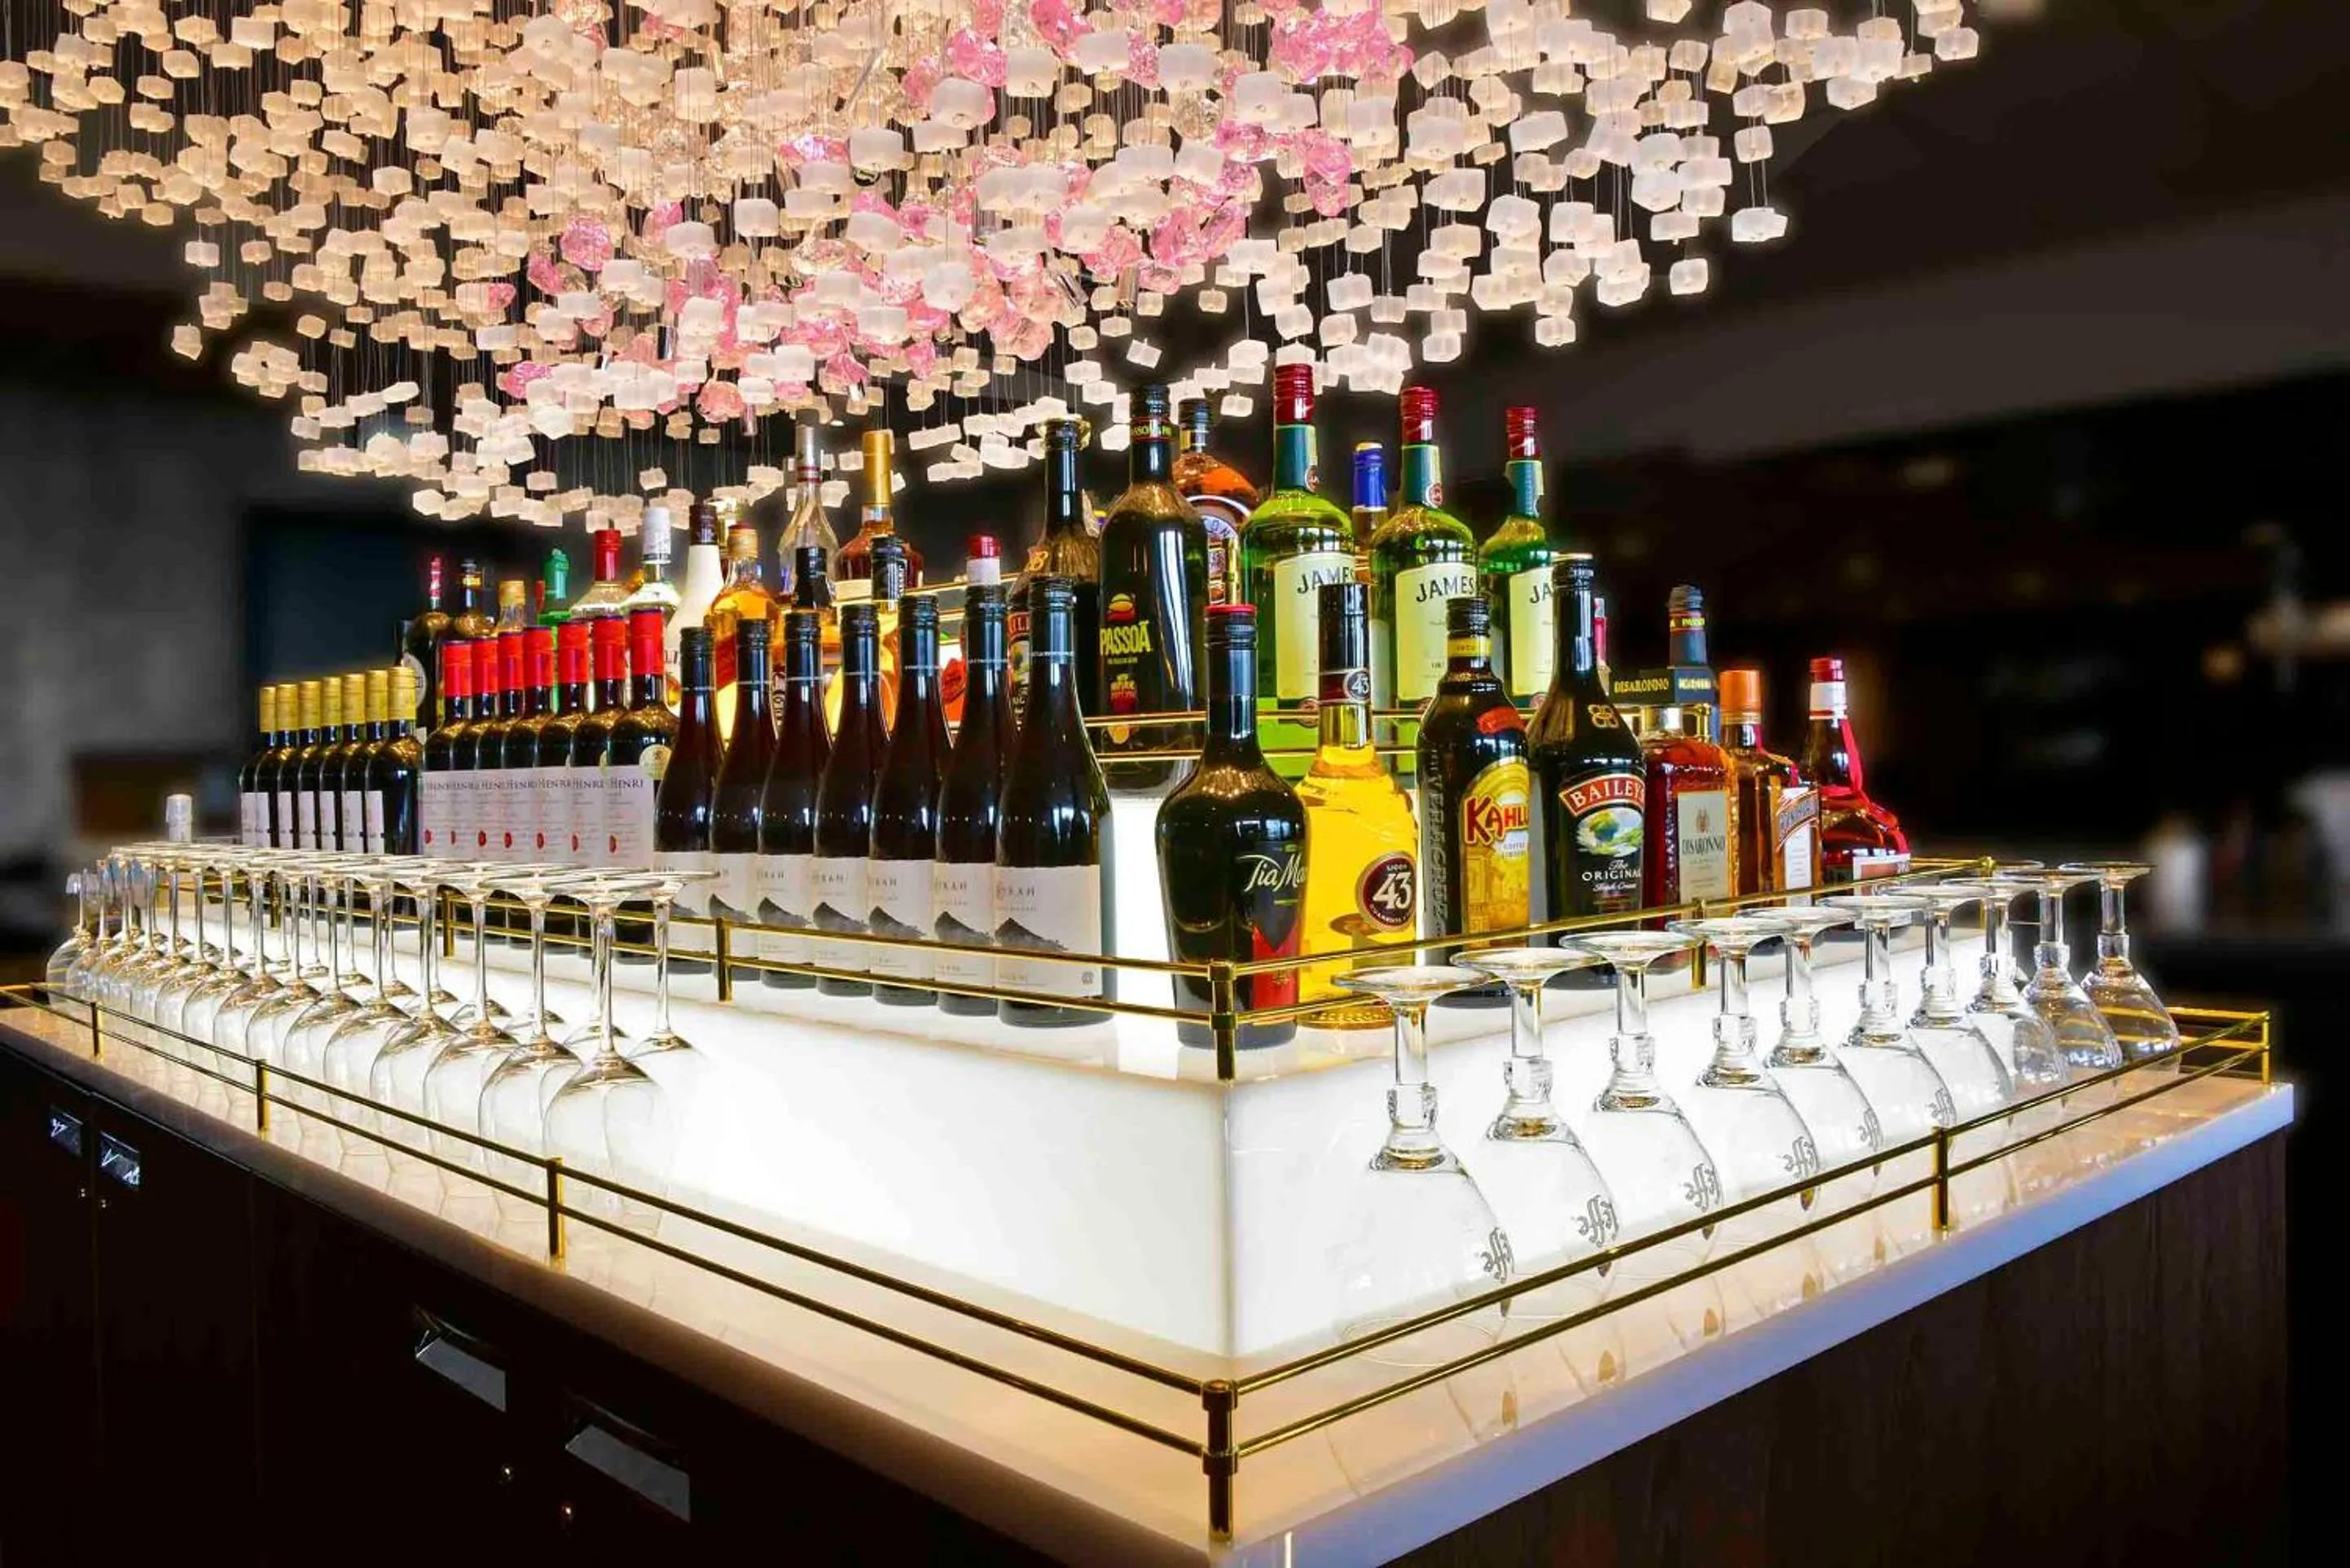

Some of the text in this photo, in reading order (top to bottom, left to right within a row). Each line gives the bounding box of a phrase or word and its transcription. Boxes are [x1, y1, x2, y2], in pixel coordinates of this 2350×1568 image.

[1351, 674, 1370, 695] 43
[610, 776, 644, 788] HENRI
[1236, 854, 1283, 892] Tia
[1373, 872, 1412, 909] 43
